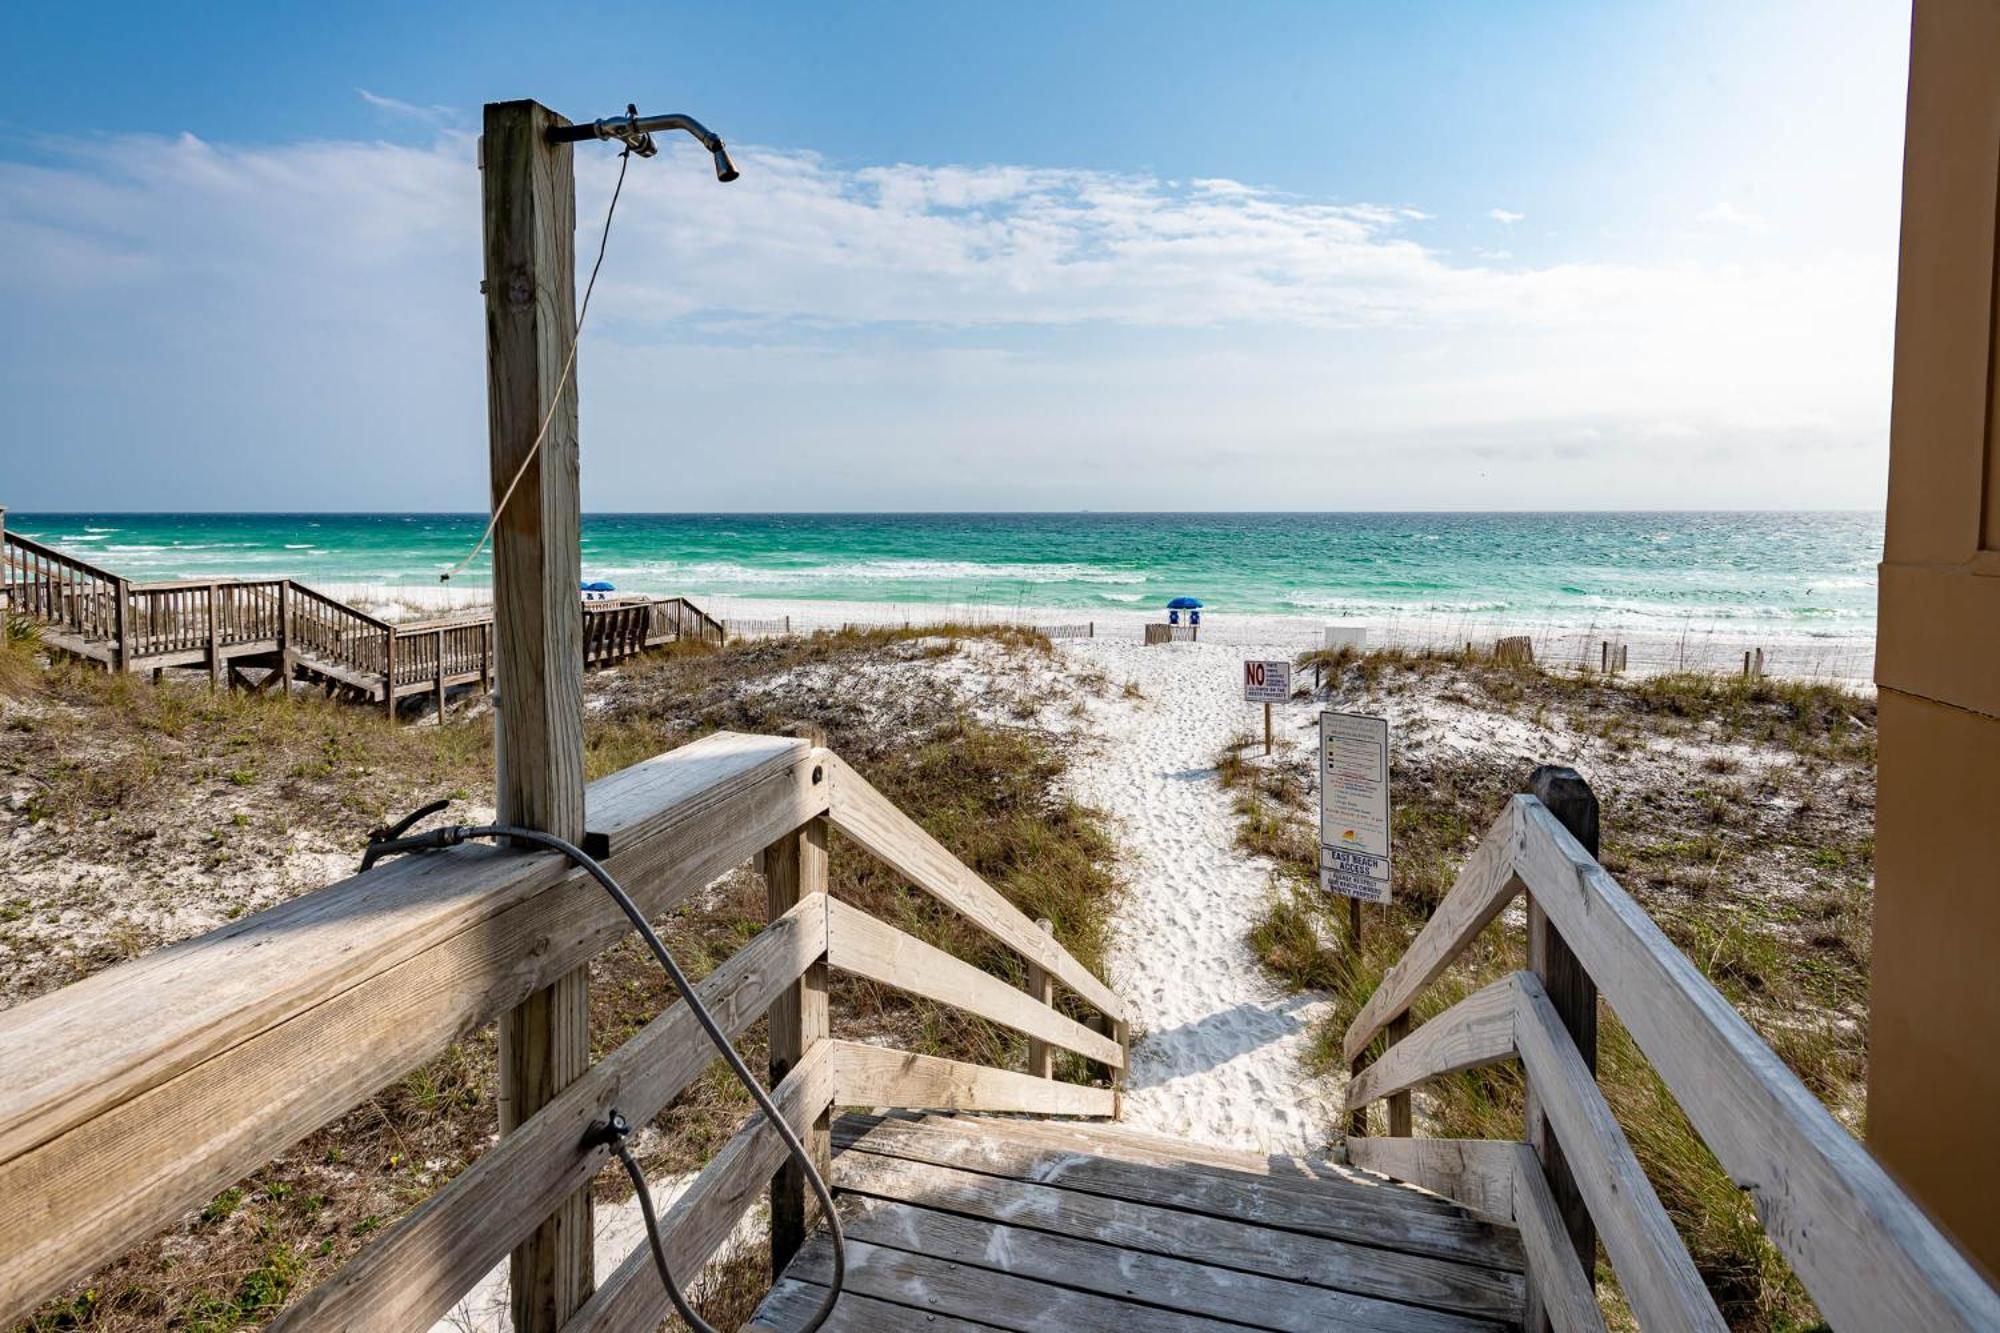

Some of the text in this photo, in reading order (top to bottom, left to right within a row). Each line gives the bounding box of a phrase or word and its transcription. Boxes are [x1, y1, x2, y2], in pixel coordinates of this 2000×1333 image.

[1247, 663, 1265, 686] NO
[1332, 851, 1378, 868] EAST BEACH
[1339, 862, 1370, 875] ACCESS
